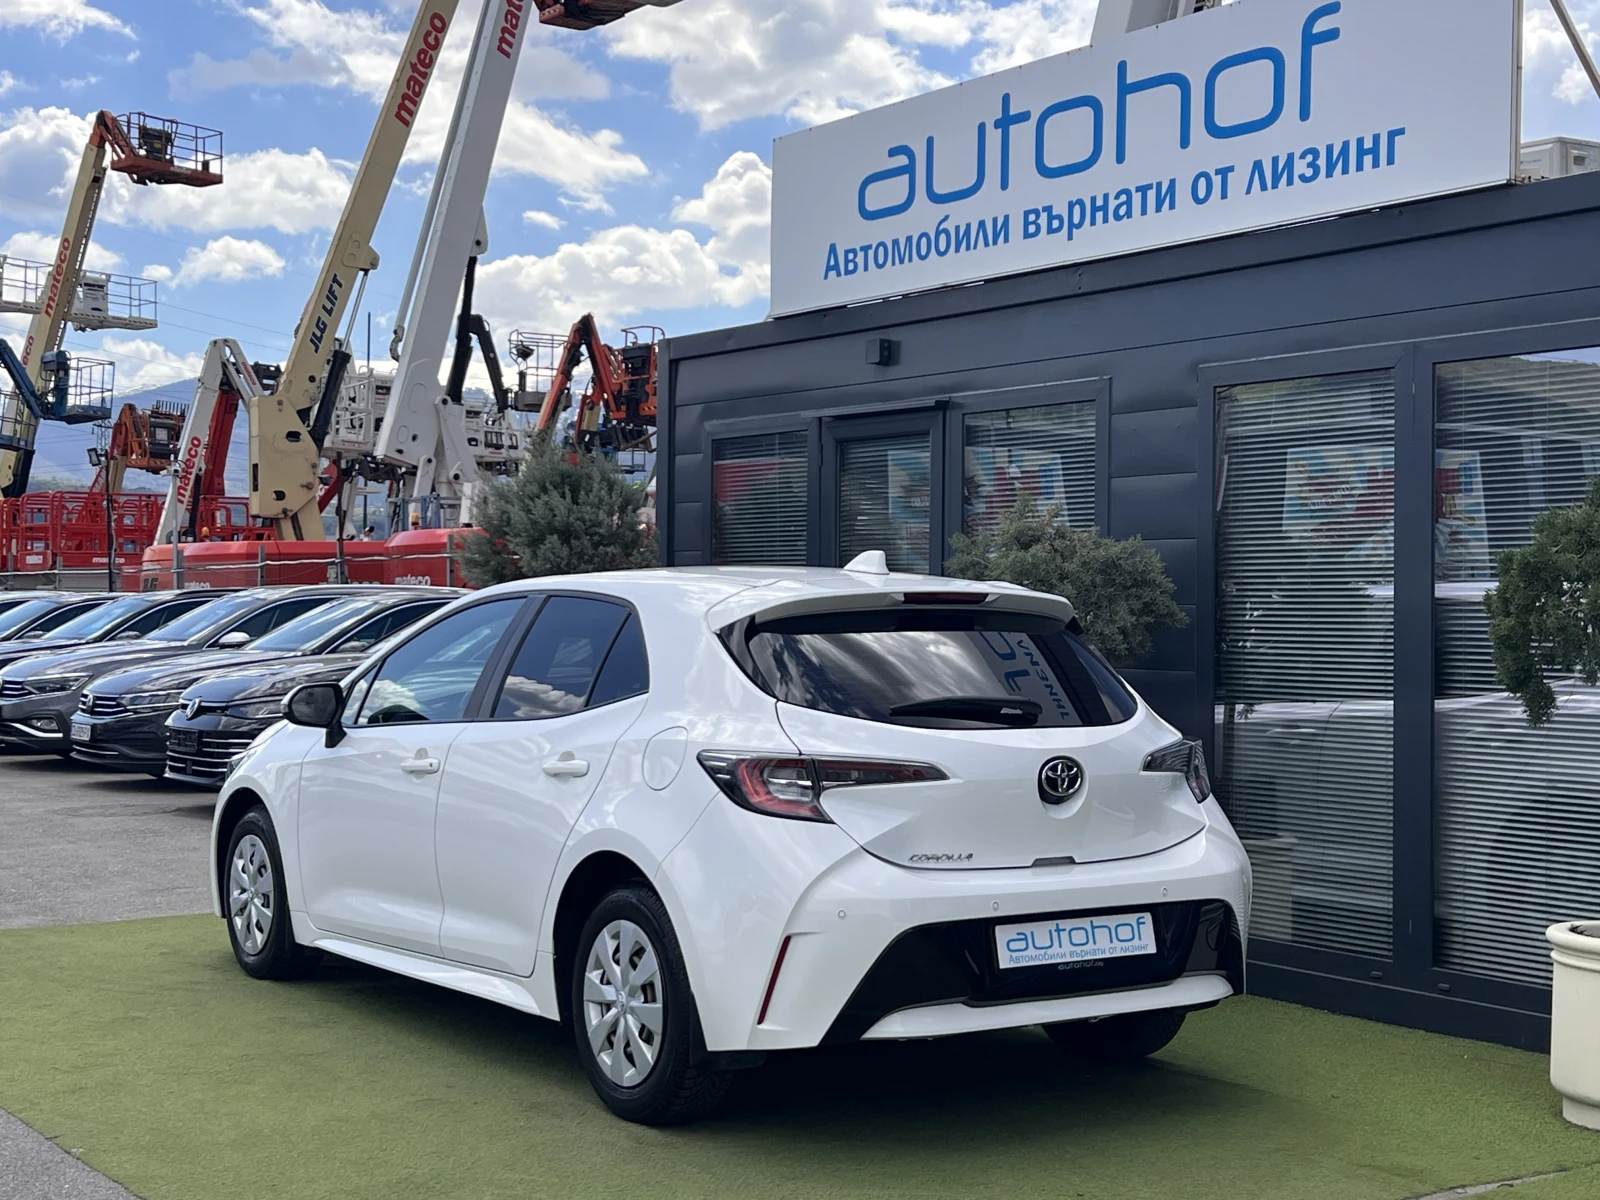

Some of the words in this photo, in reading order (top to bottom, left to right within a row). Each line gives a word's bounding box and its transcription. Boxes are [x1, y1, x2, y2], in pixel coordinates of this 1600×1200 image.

[497, 0, 525, 59] mat
[395, 12, 447, 128] mateco
[858, 1, 1341, 222] autohof
[824, 214, 1010, 280] Автомобили
[1023, 178, 1176, 241] върнати
[1191, 165, 1235, 206] от
[1246, 127, 1406, 195] лизинг
[45, 237, 71, 318] mateco
[309, 315, 329, 354] JLG
[321, 272, 343, 317] LIFT
[22, 335, 35, 367] eco
[177, 436, 202, 505] mateco
[92, 556, 126, 564] maco
[1006, 916, 1146, 952] autohof
[1009, 950, 1067, 964] Автомобили
[1069, 947, 1106, 960] върнати
[1108, 946, 1118, 955] от
[1120, 943, 1149, 953] лизинг
